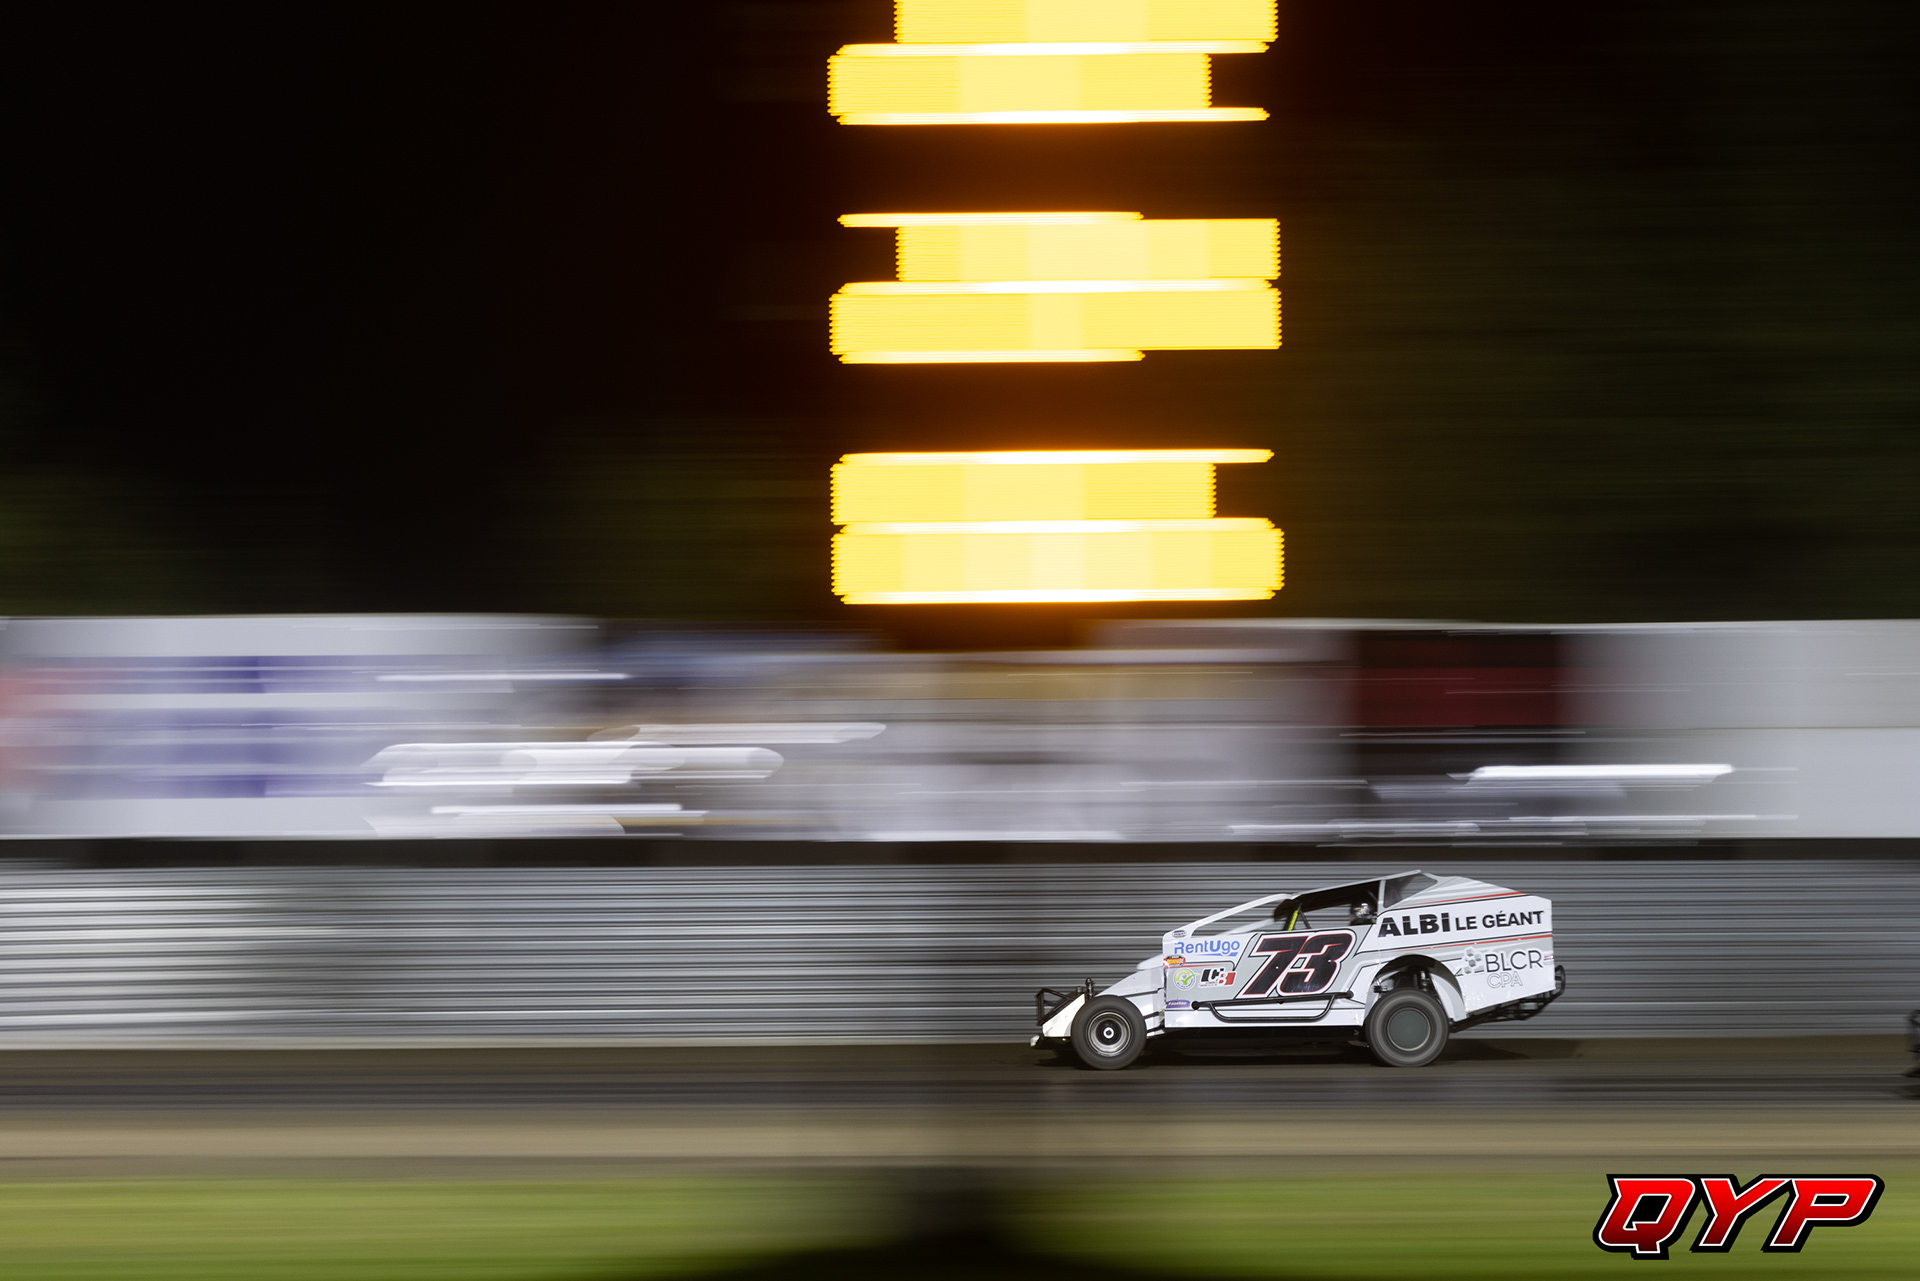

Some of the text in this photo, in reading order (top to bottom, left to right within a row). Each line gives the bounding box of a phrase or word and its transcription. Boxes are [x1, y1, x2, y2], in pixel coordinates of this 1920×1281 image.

[1377, 910, 1544, 938] ALBI LE GÉANT
[1174, 940, 1240, 955] RentUgo
[1240, 931, 1354, 996] 73
[1485, 950, 1544, 973] BLCR
[1486, 970, 1524, 989] CPA
